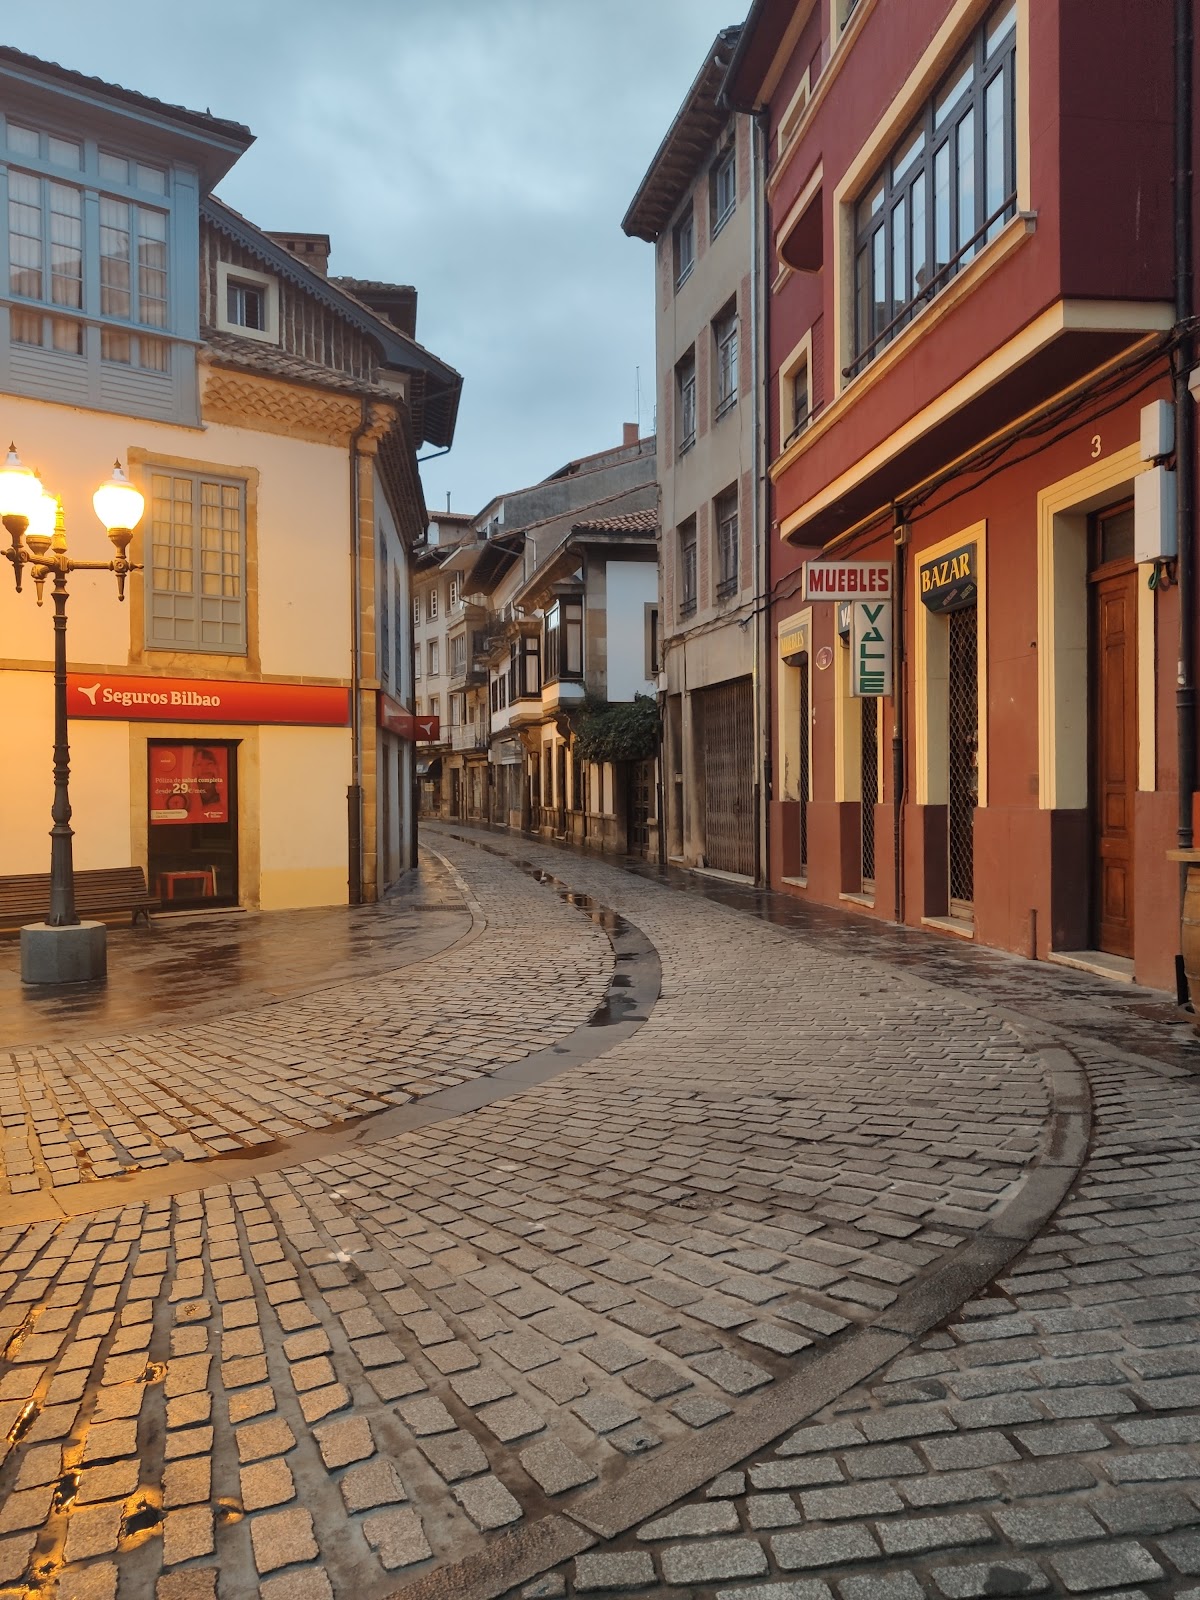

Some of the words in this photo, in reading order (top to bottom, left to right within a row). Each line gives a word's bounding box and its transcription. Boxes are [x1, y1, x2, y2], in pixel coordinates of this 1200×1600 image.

[1091, 434, 1101, 458] 3
[809, 568, 889, 592] MUEBLES
[921, 552, 970, 593] BAZAR
[860, 604, 885, 693] VALLE
[102, 688, 168, 707] Seguros
[170, 691, 221, 707] Bilbao
